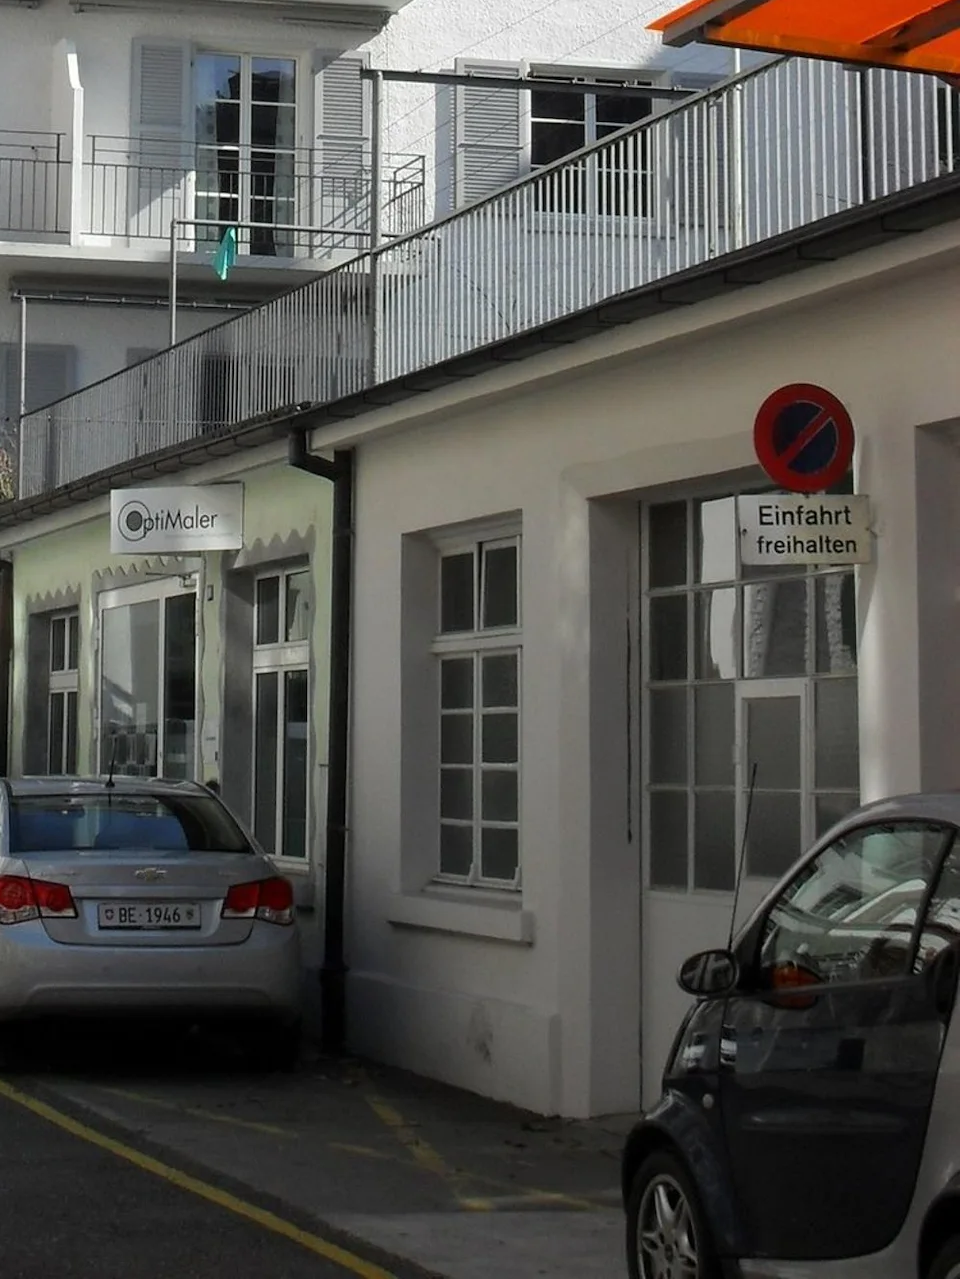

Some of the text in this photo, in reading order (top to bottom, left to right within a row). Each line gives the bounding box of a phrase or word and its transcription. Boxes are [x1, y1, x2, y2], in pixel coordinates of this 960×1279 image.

[118, 500, 218, 542] OptiMaler
[759, 505, 852, 526] Einfahrt
[757, 535, 857, 554] freihalten
